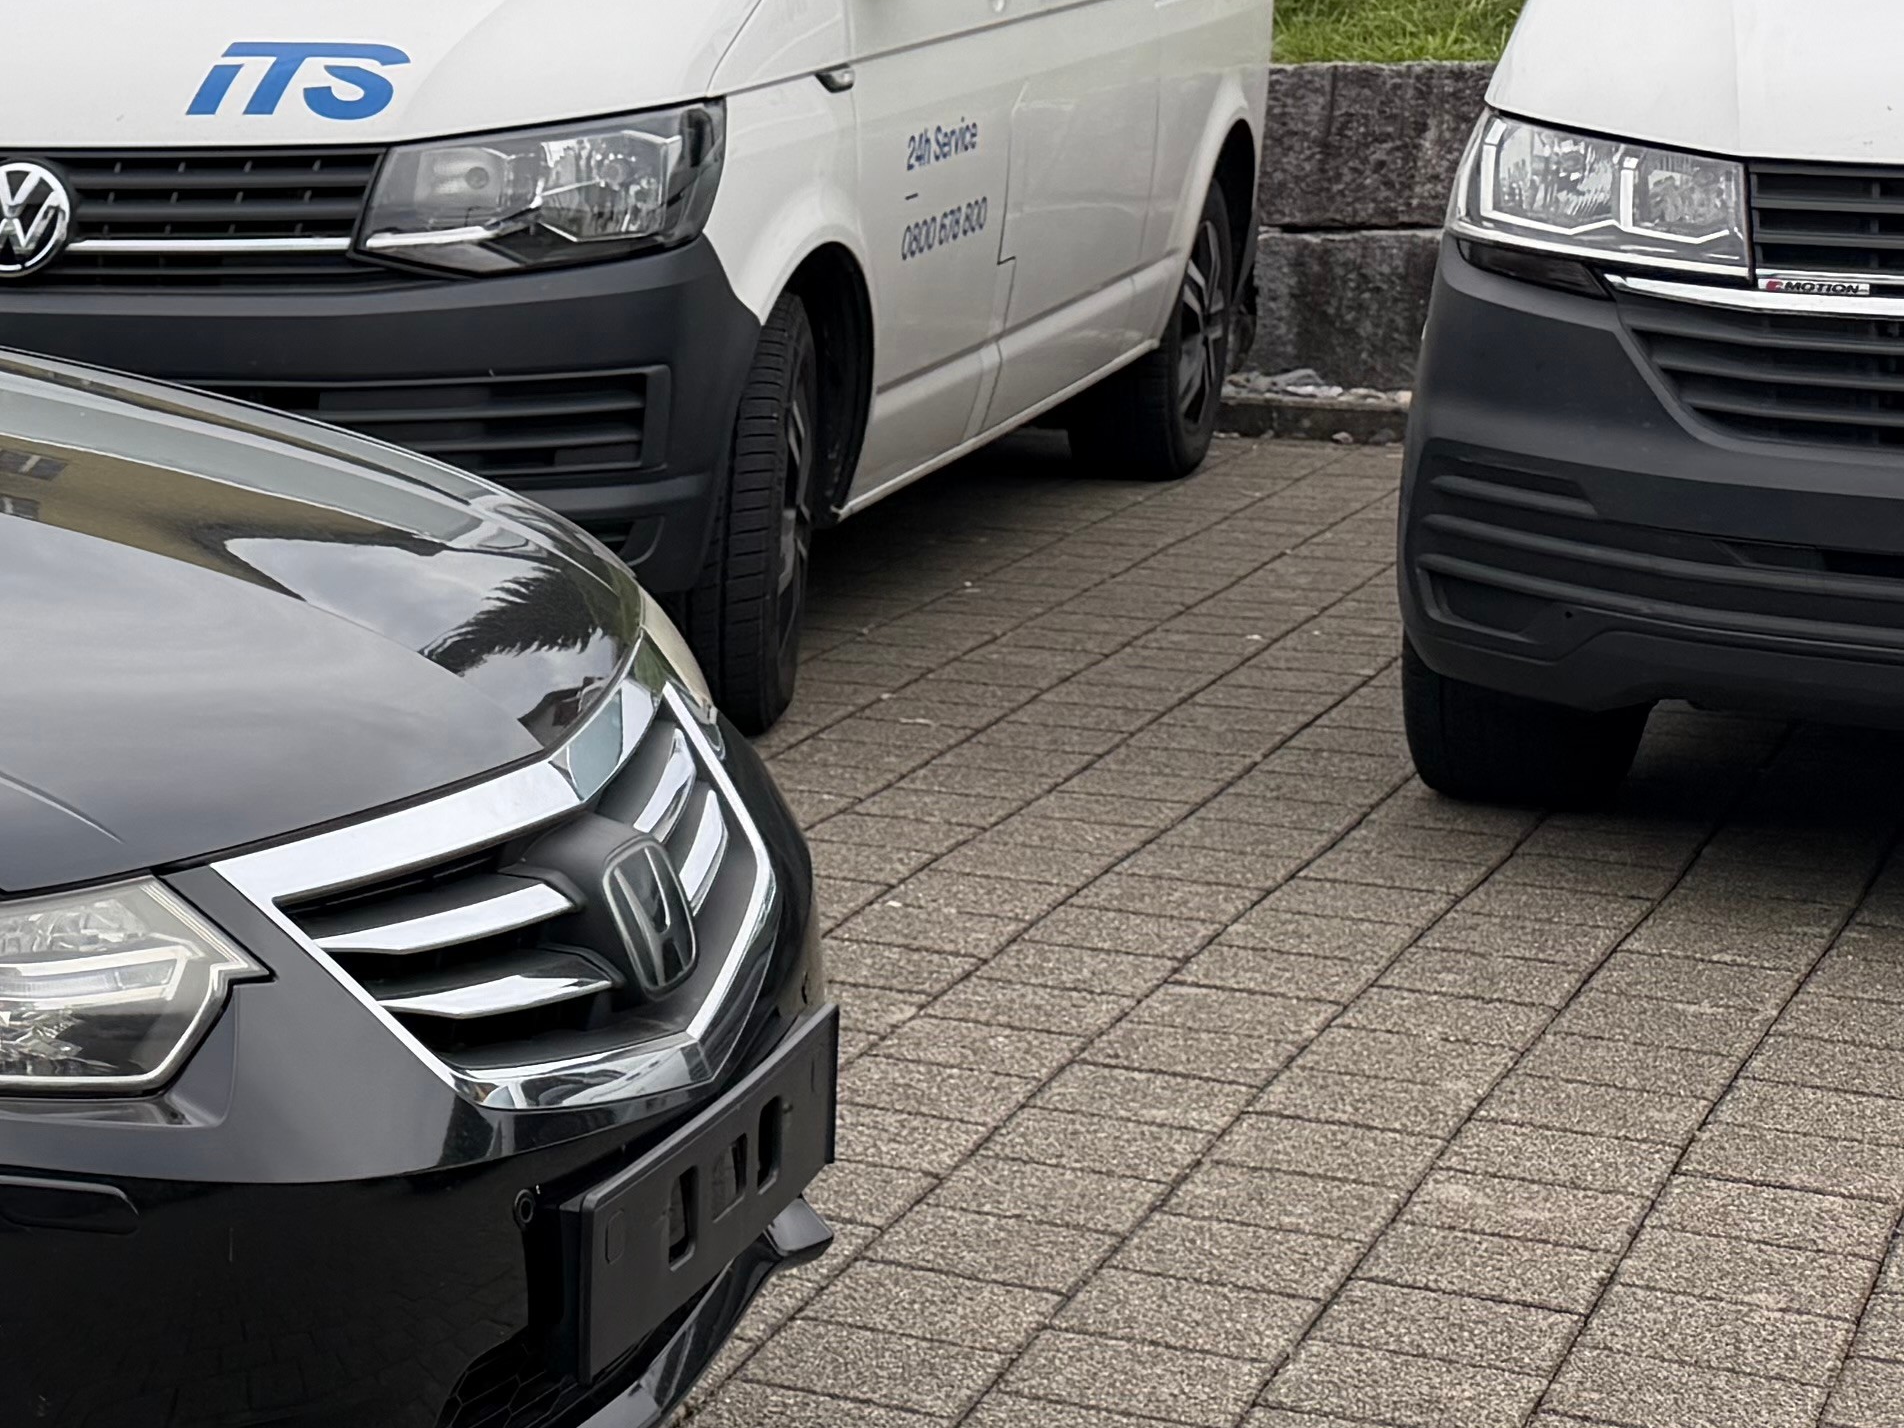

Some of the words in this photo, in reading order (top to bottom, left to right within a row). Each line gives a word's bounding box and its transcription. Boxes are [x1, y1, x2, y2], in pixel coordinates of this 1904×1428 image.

[906, 128, 932, 172] 24h
[933, 116, 978, 162] Service
[901, 215, 938, 261] 0800
[938, 205, 962, 246] 678
[962, 196, 989, 237] 800
